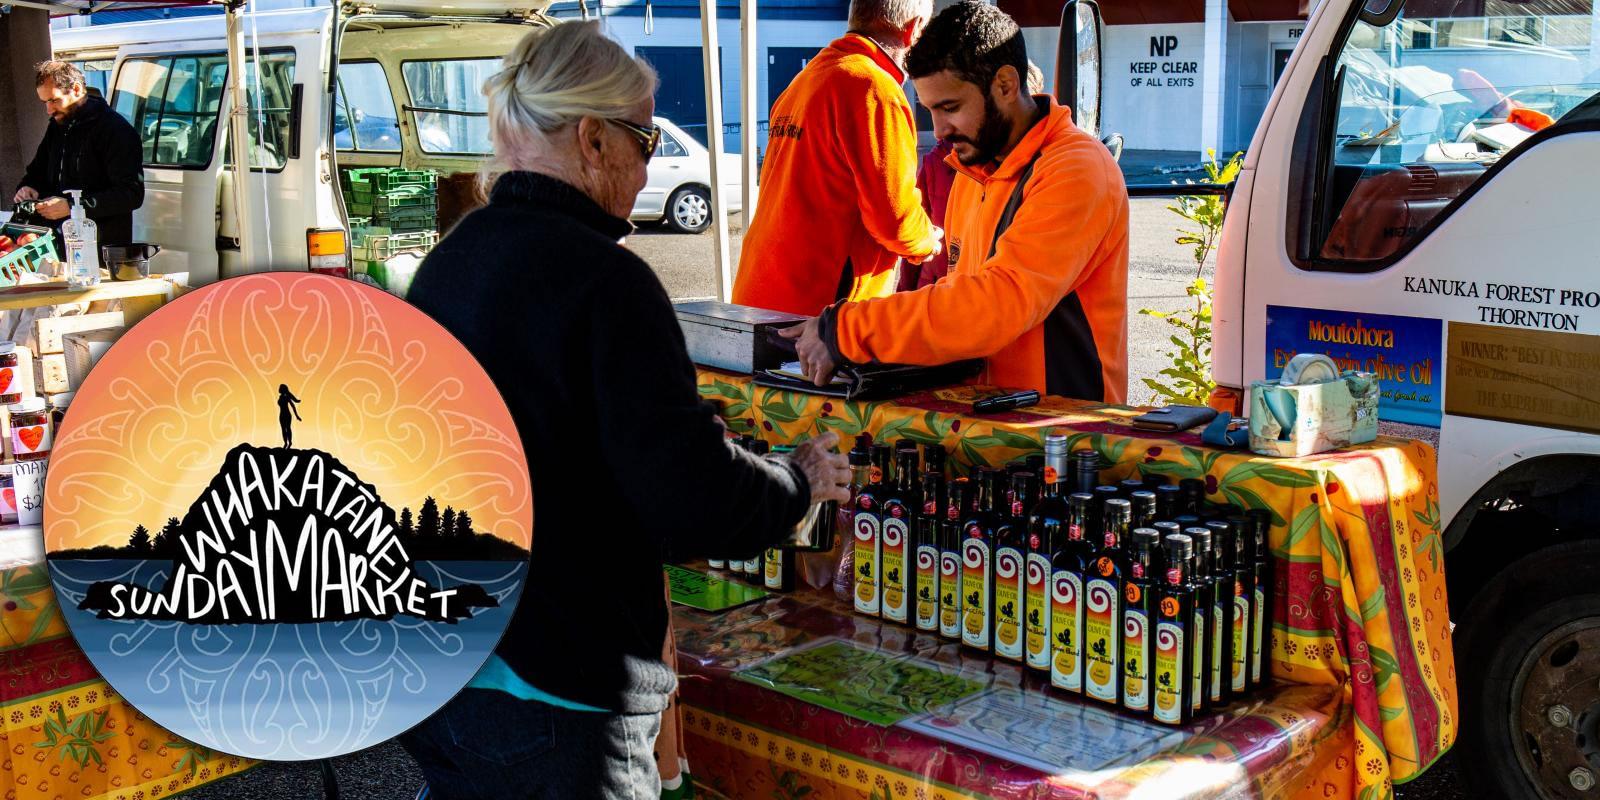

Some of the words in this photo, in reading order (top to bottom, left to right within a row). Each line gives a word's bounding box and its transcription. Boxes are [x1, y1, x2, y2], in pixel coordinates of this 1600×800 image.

[1150, 35, 1178, 57] NP
[1130, 62, 1158, 74] KEEP
[1162, 62, 1197, 73] CLEAR
[1131, 78, 1142, 87] OF
[1146, 78, 1162, 87] ALL
[1167, 78, 1194, 87] EXITS
[1404, 276, 1479, 298] KANUKA
[1485, 283, 1555, 305] FOREST
[1559, 290, 1600, 308] PRO
[1477, 306, 1579, 332] THORNTON
[1309, 319, 1394, 348] Moutohora
[1460, 340, 1509, 361] WINNER:
[1365, 354, 1406, 382] Olive
[1410, 357, 1432, 385] Oil
